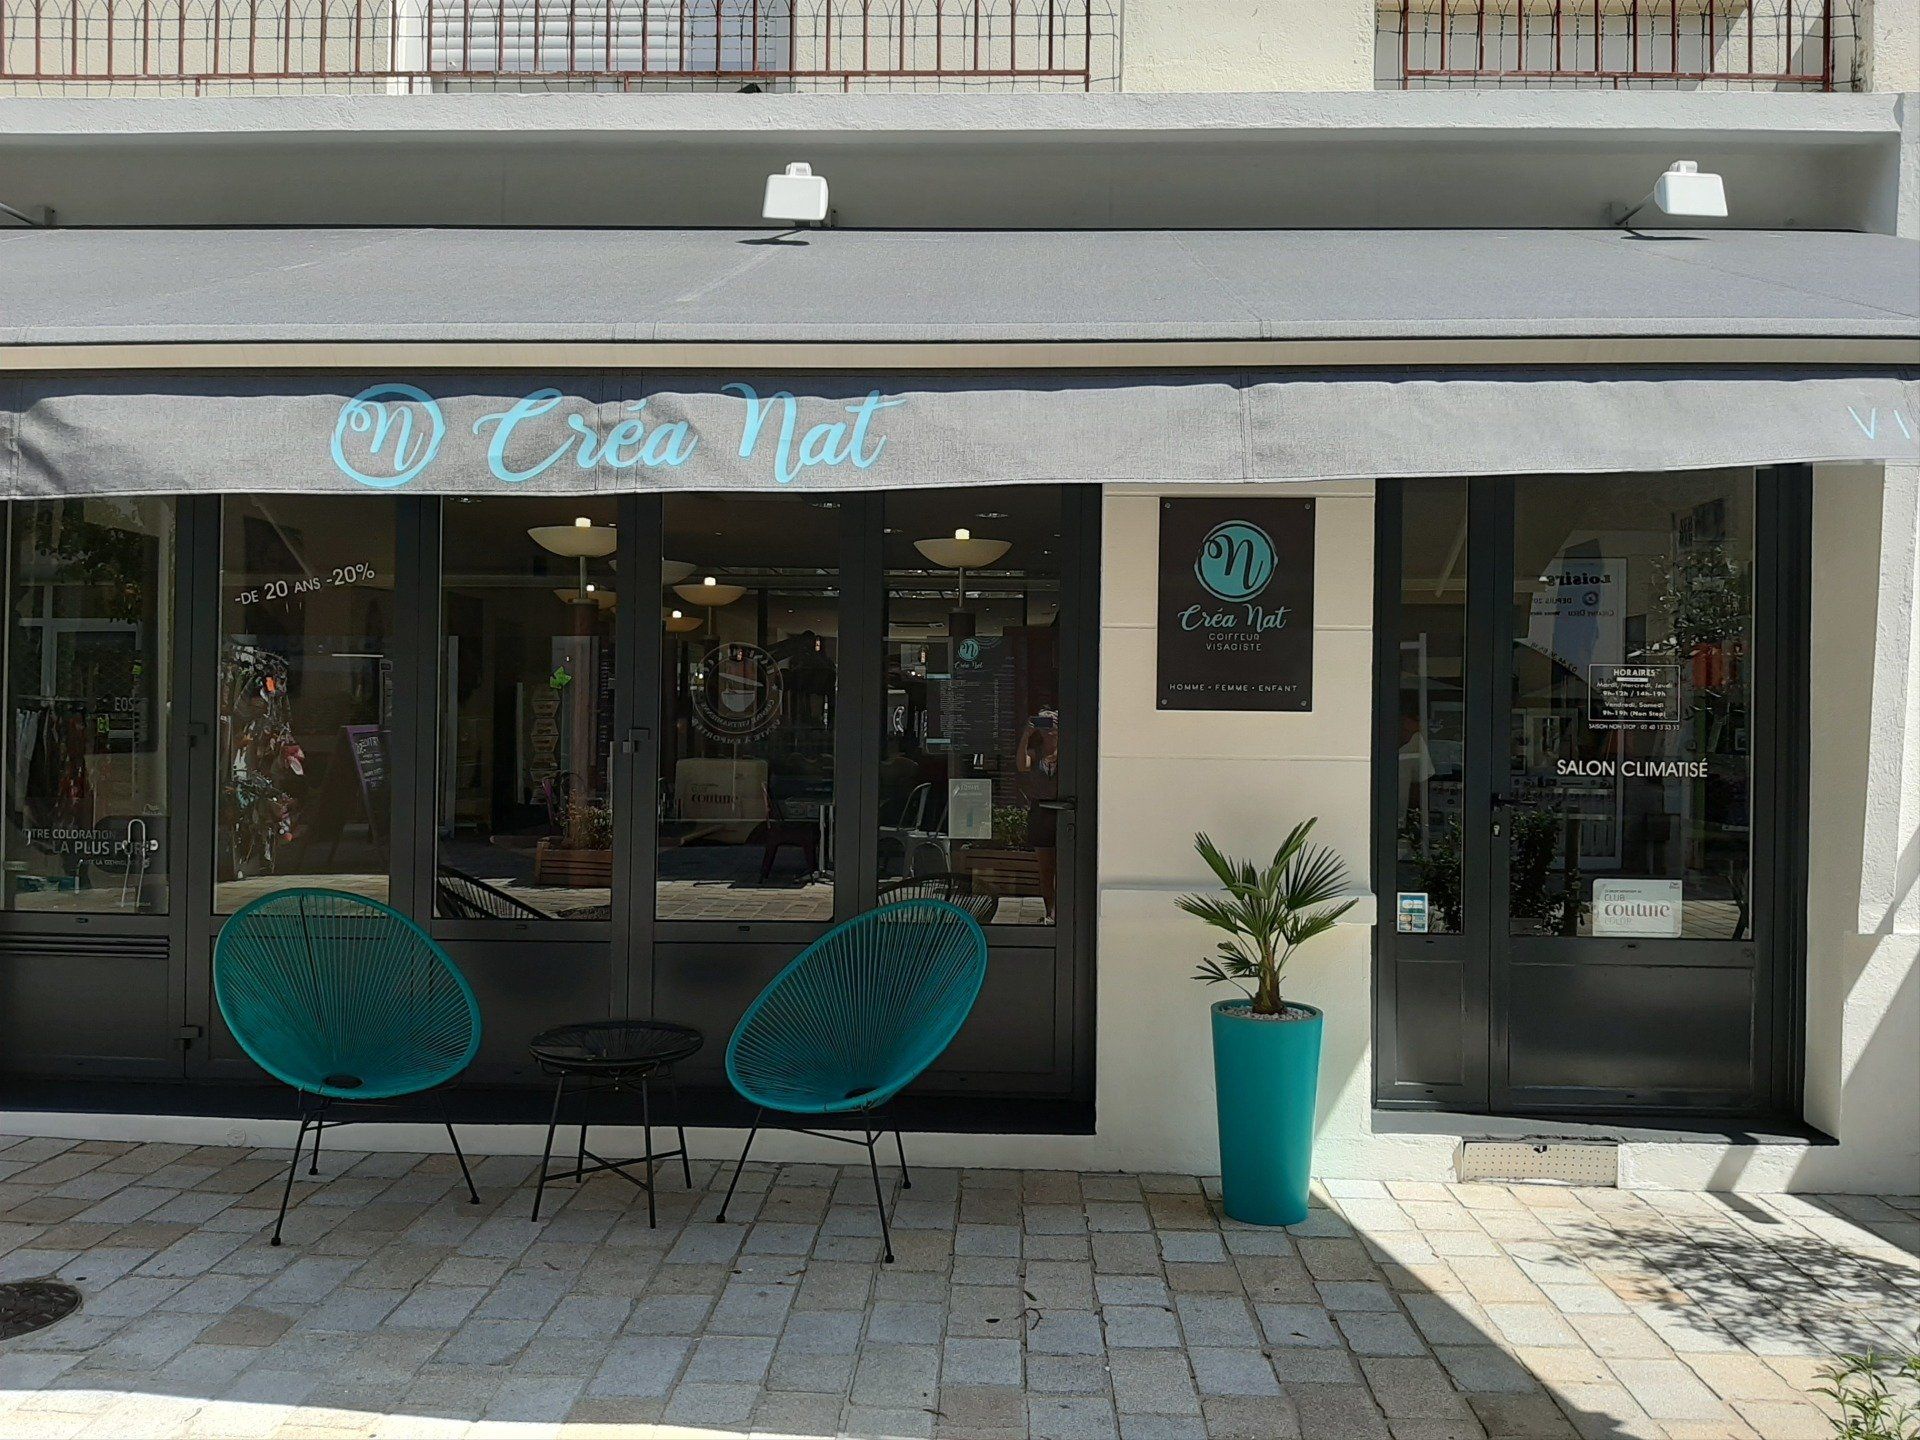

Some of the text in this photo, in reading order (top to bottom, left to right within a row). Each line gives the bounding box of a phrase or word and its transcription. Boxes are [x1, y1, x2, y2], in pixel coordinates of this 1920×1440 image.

[472, 383, 909, 484] Créa Nat
[264, 580, 288, 600] 20
[294, 577, 320, 593] ANS
[326, 562, 375, 585] -20%
[1178, 603, 1292, 633] Créa Nat
[1208, 633, 1260, 641] COIFFEUR
[1206, 643, 1262, 651] VISAGISTE
[1613, 668, 1656, 677] HORAIRES
[1168, 683, 1205, 691] HOMME
[1258, 684, 1298, 692] ENFANT
[1556, 757, 1708, 777] SALON CLIMATISÉ
[74, 842, 110, 855] PLUS
